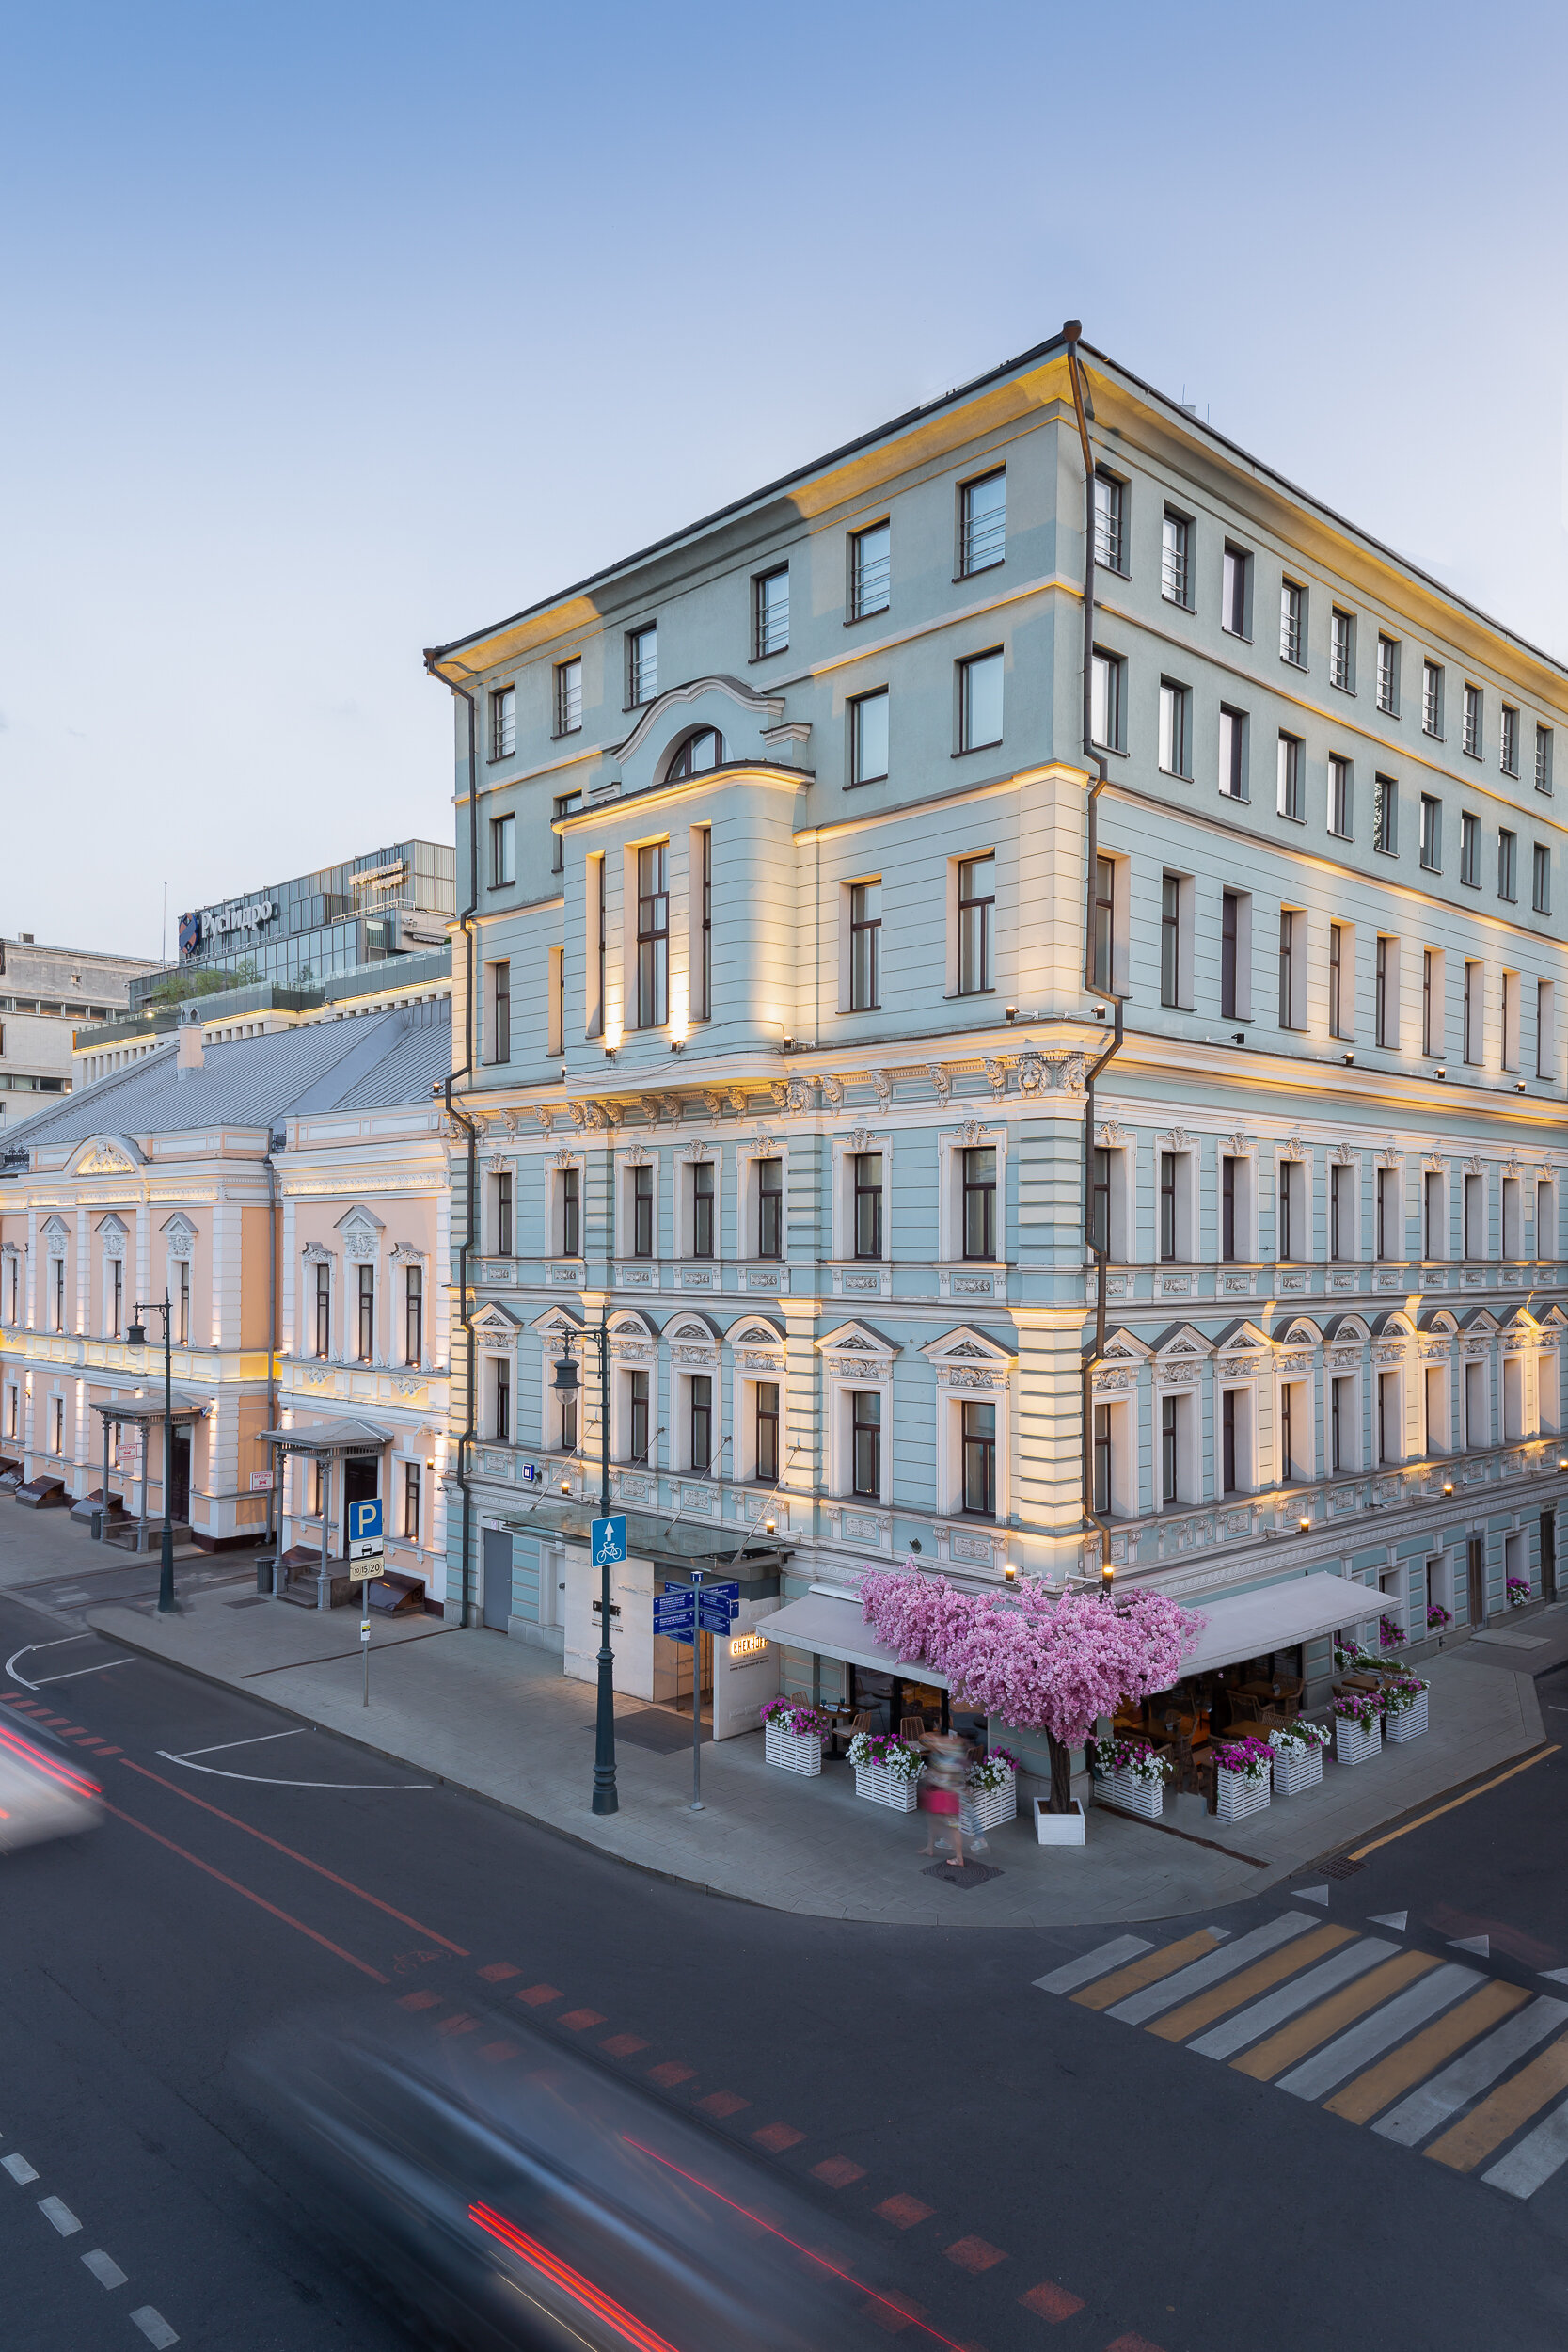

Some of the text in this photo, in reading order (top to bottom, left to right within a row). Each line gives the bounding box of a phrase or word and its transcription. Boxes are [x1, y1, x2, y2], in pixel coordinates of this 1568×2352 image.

[201, 900, 273, 943] РусГидро
[358, 1504, 377, 1536] P
[361, 1565, 368, 1574] 15
[370, 1563, 380, 1573] 20
